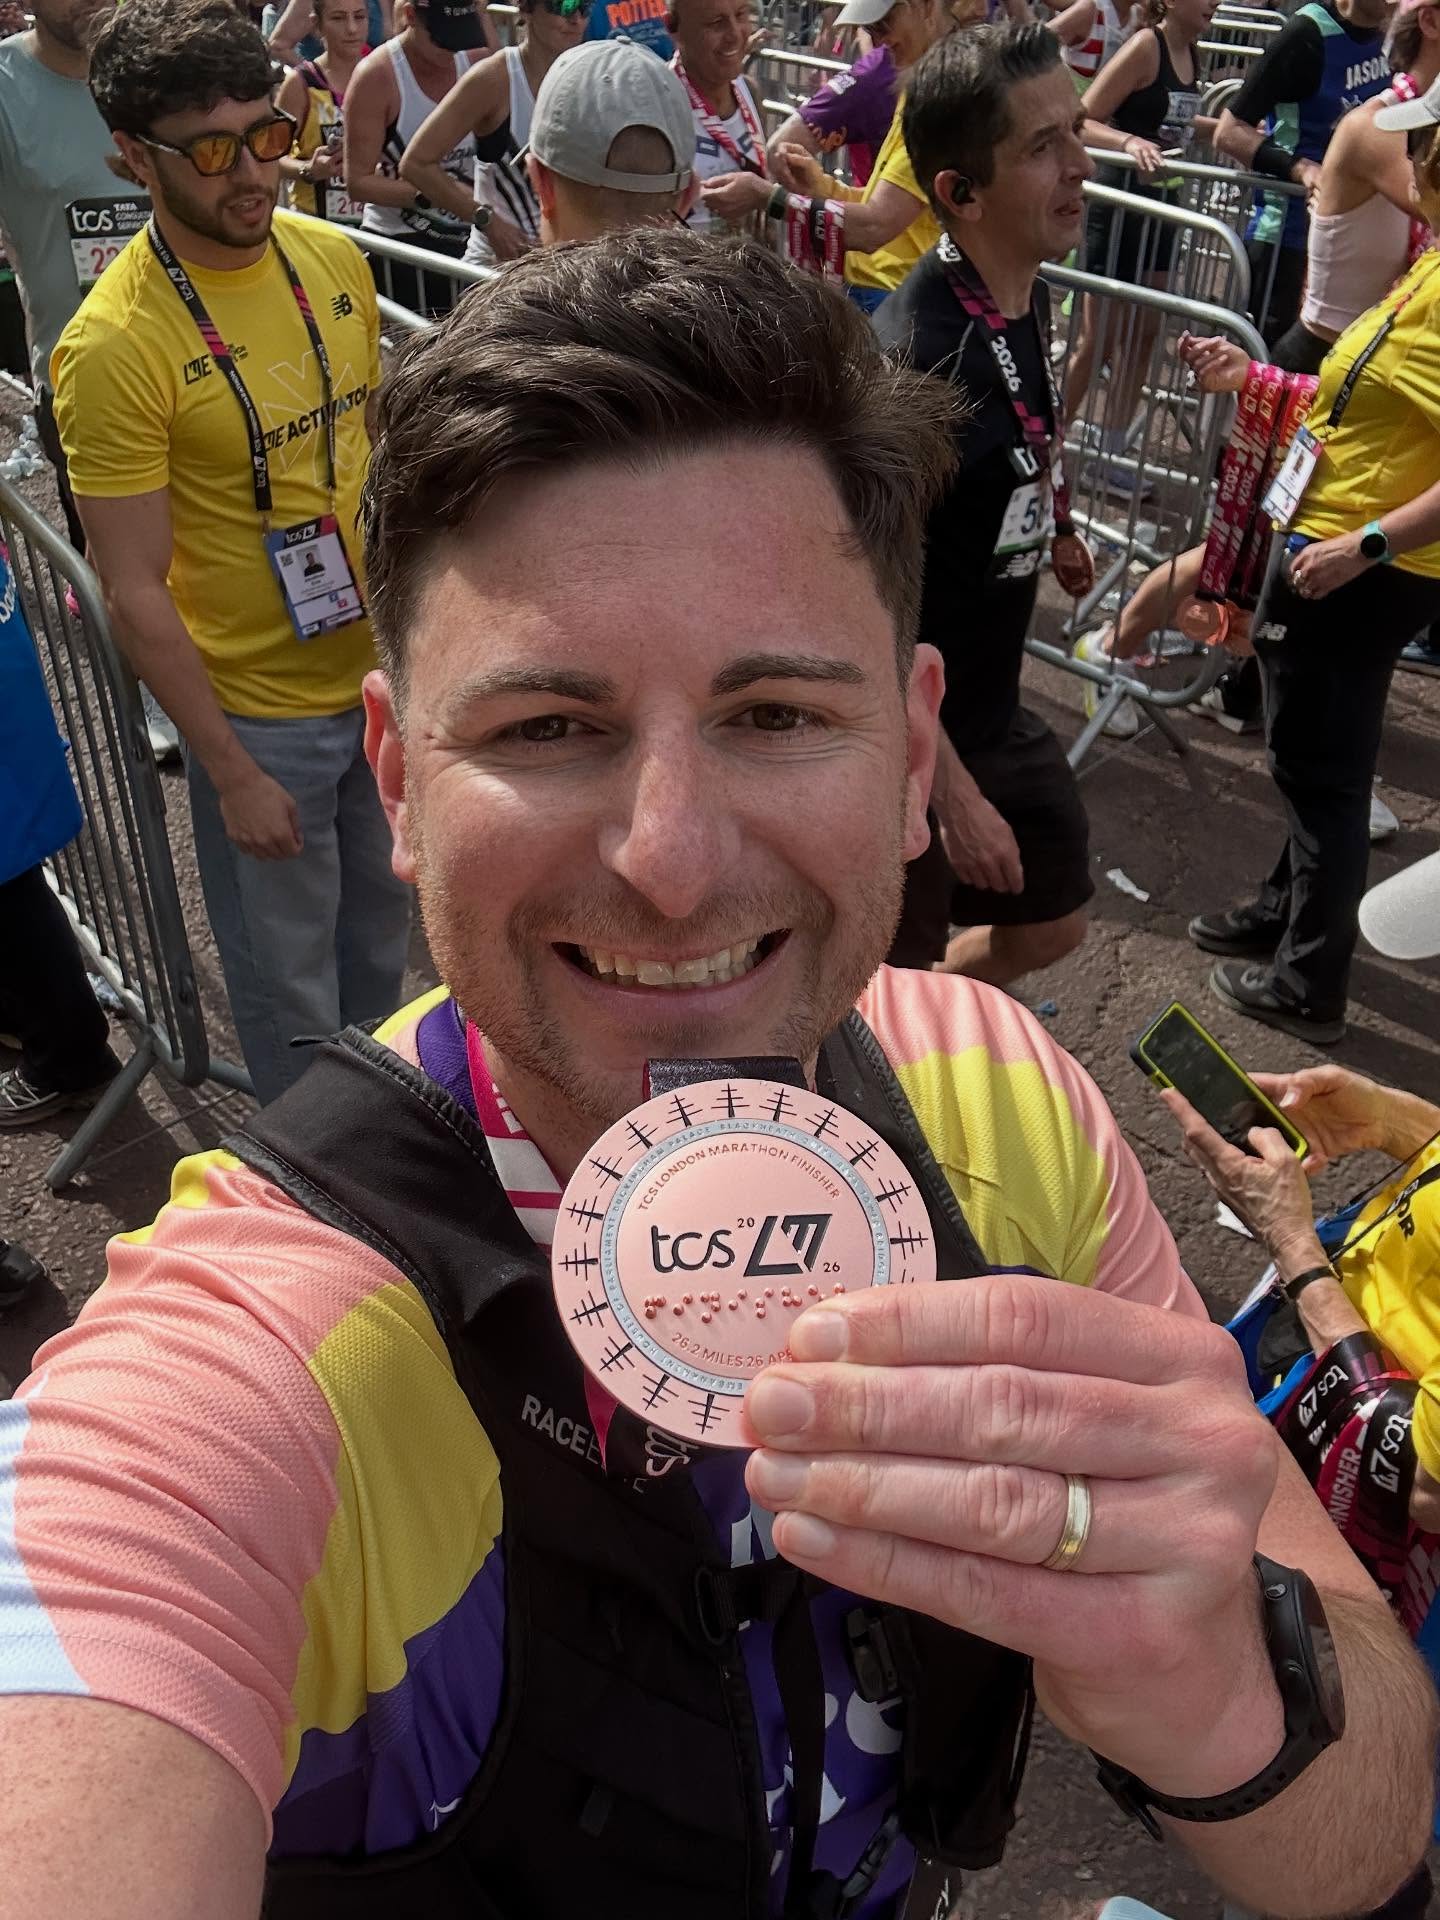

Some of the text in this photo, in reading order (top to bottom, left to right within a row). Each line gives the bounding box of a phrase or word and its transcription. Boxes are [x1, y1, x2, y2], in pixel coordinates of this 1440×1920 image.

[1345, 54, 1395, 91] JASON
[71, 206, 114, 233] tcs
[113, 202, 138, 212] TATA
[990, 335, 1023, 394] 2026
[1220, 464, 1241, 502] 2026
[637, 1142, 841, 1211] TCS LONDON MARATHON FINISHER
[650, 1224, 736, 1274] tcs
[736, 1216, 756, 1229] 20
[822, 1261, 842, 1274] 26
[671, 1332, 701, 1357] 26.2
[701, 1347, 743, 1367] MILES
[746, 1354, 764, 1369] 26
[1317, 1364, 1351, 1397] tcs
[1379, 1414, 1414, 1456] tcs
